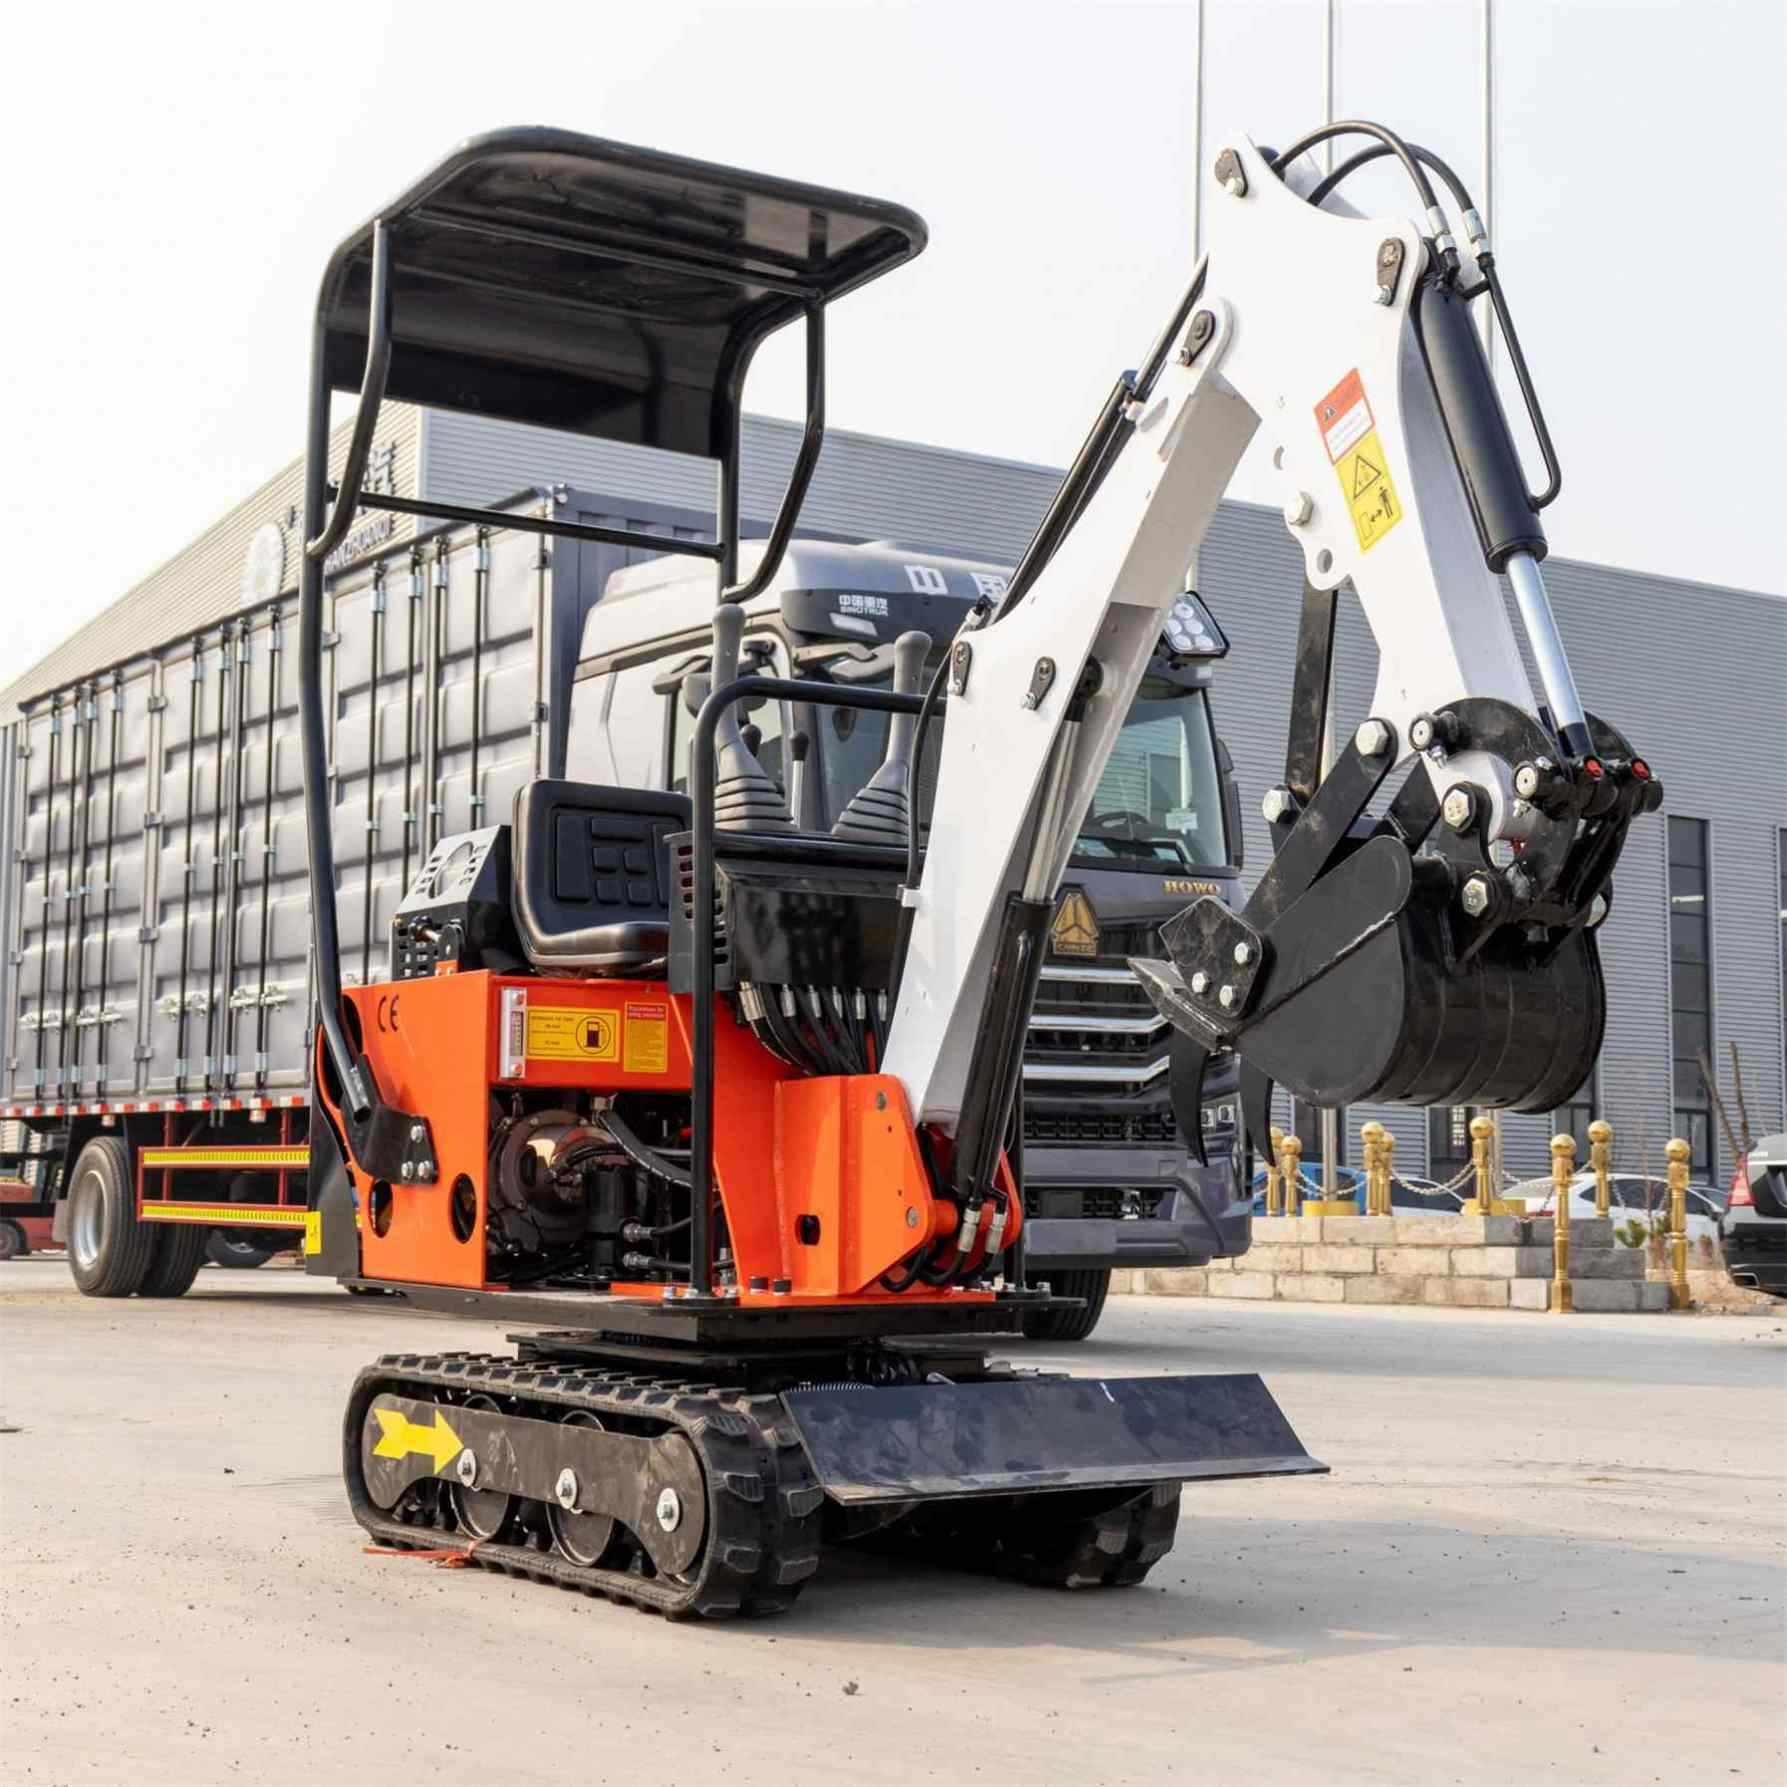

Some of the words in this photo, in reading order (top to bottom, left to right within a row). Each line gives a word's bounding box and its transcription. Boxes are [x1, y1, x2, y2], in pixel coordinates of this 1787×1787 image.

[838, 594, 888, 608] 中国重汽
[840, 605, 888, 617] SINOTRUK
[1163, 880, 1221, 895] HOWO
